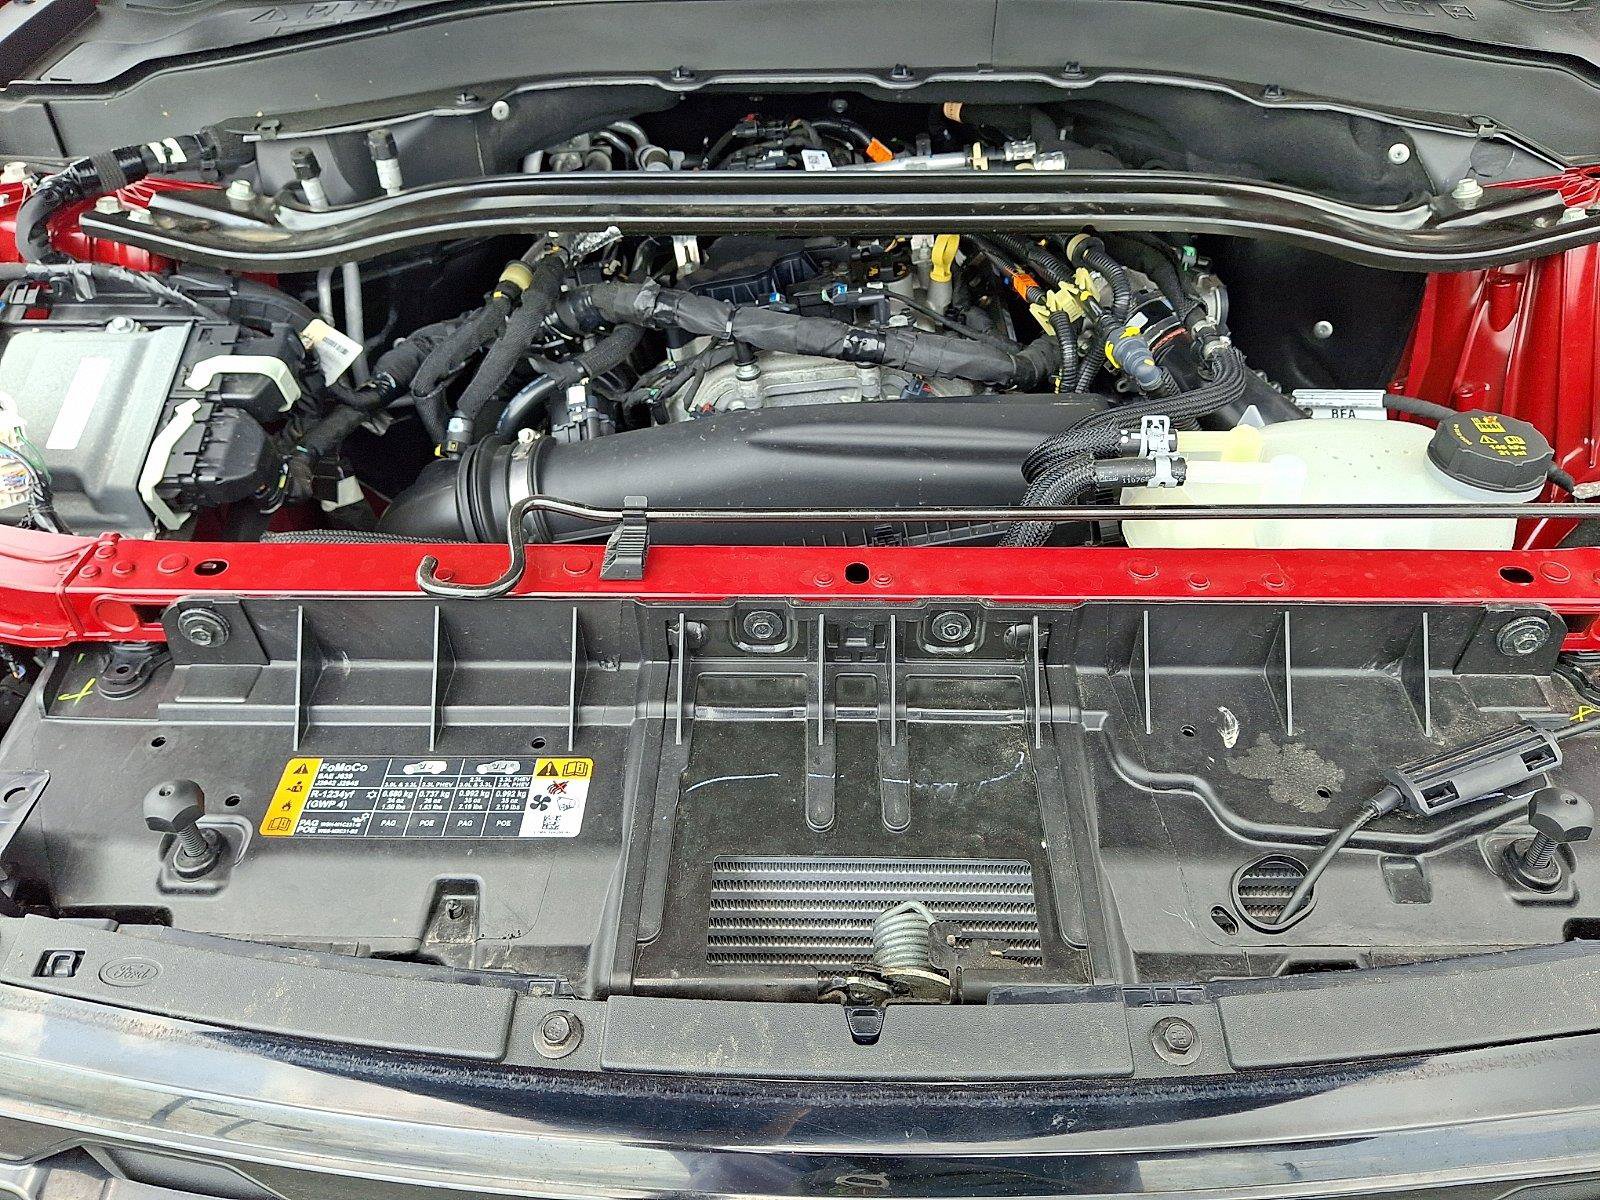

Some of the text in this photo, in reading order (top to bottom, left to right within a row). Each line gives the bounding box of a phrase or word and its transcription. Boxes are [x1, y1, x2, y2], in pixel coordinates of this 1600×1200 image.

[319, 762, 369, 772] FoMoCo
[309, 790, 356, 800] R-1234yf
[403, 790, 414, 799] kg
[440, 790, 450, 799] kg
[480, 790, 491, 799] kg
[517, 790, 527, 799] kg
[306, 800, 348, 810] (GWP 4)
[298, 819, 319, 827] PAG
[380, 819, 397, 827] PAG
[419, 819, 435, 827] POE
[457, 819, 473, 827] PAG
[496, 819, 512, 827] POE
[113, 964, 151, 979] Ford
